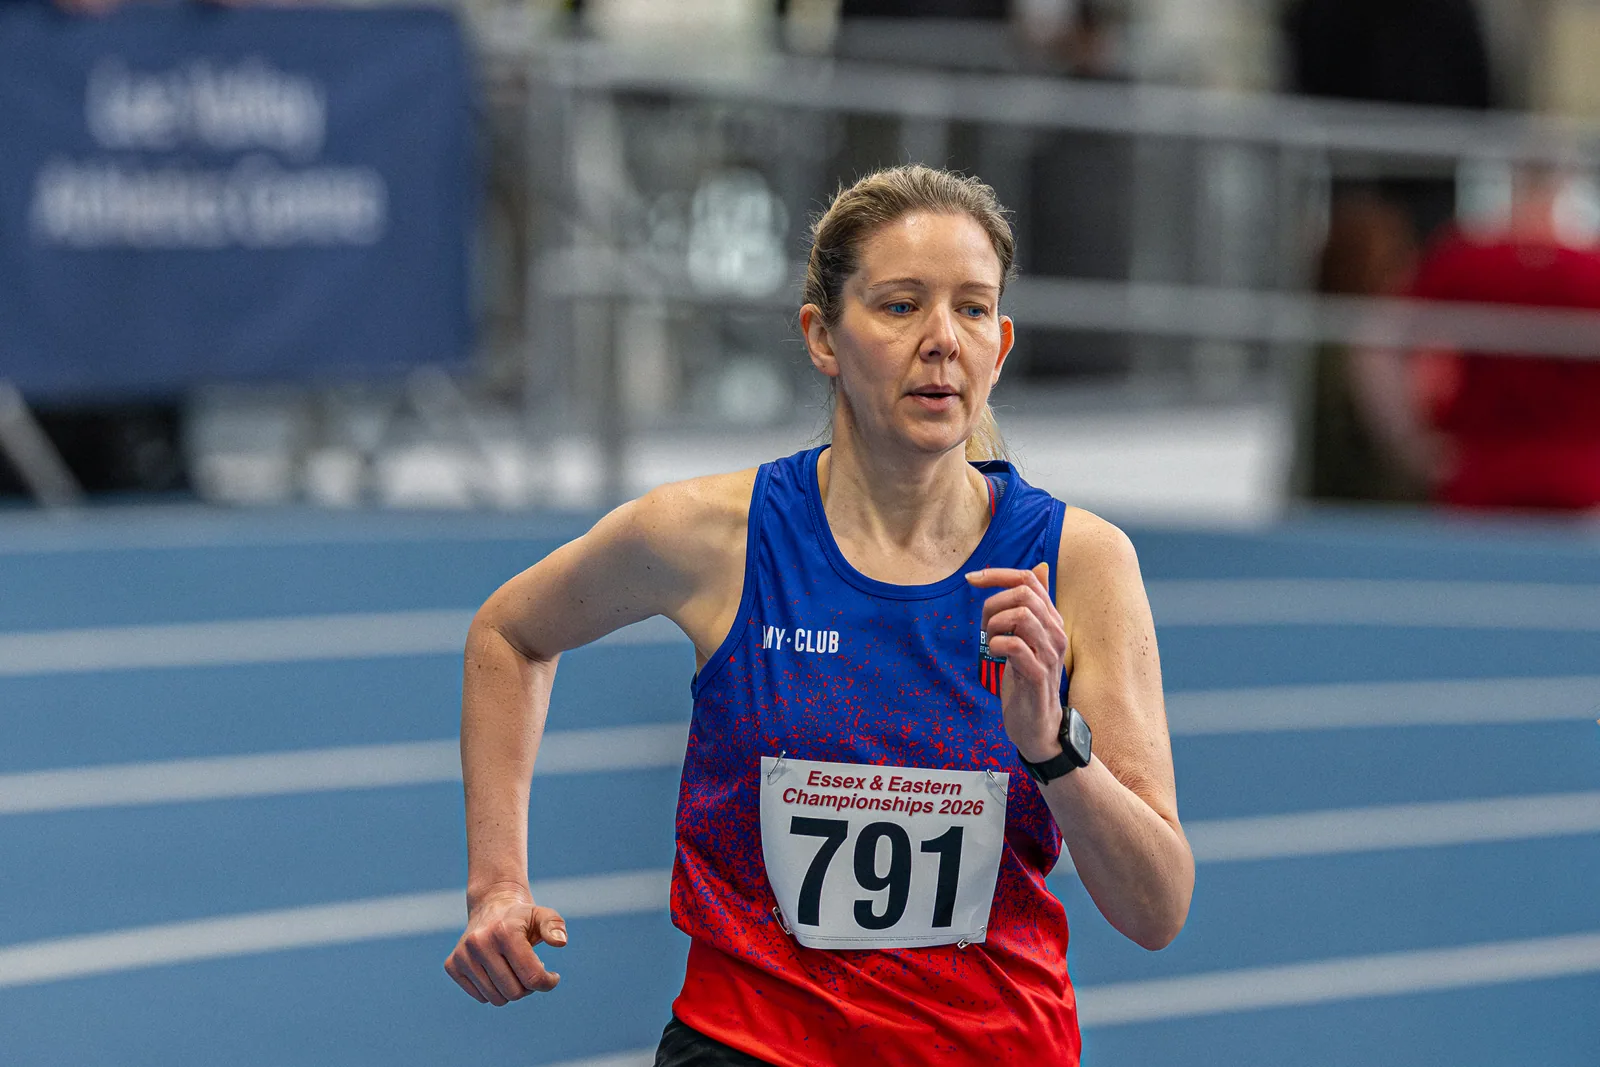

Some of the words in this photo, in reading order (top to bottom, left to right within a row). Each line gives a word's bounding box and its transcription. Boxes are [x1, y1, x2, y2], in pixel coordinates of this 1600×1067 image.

[807, 770, 866, 790] Essex
[869, 775, 883, 791] &
[887, 776, 962, 796] Eastern
[782, 787, 933, 816] Championships
[938, 799, 984, 815] 2026
[789, 816, 963, 929] 791
